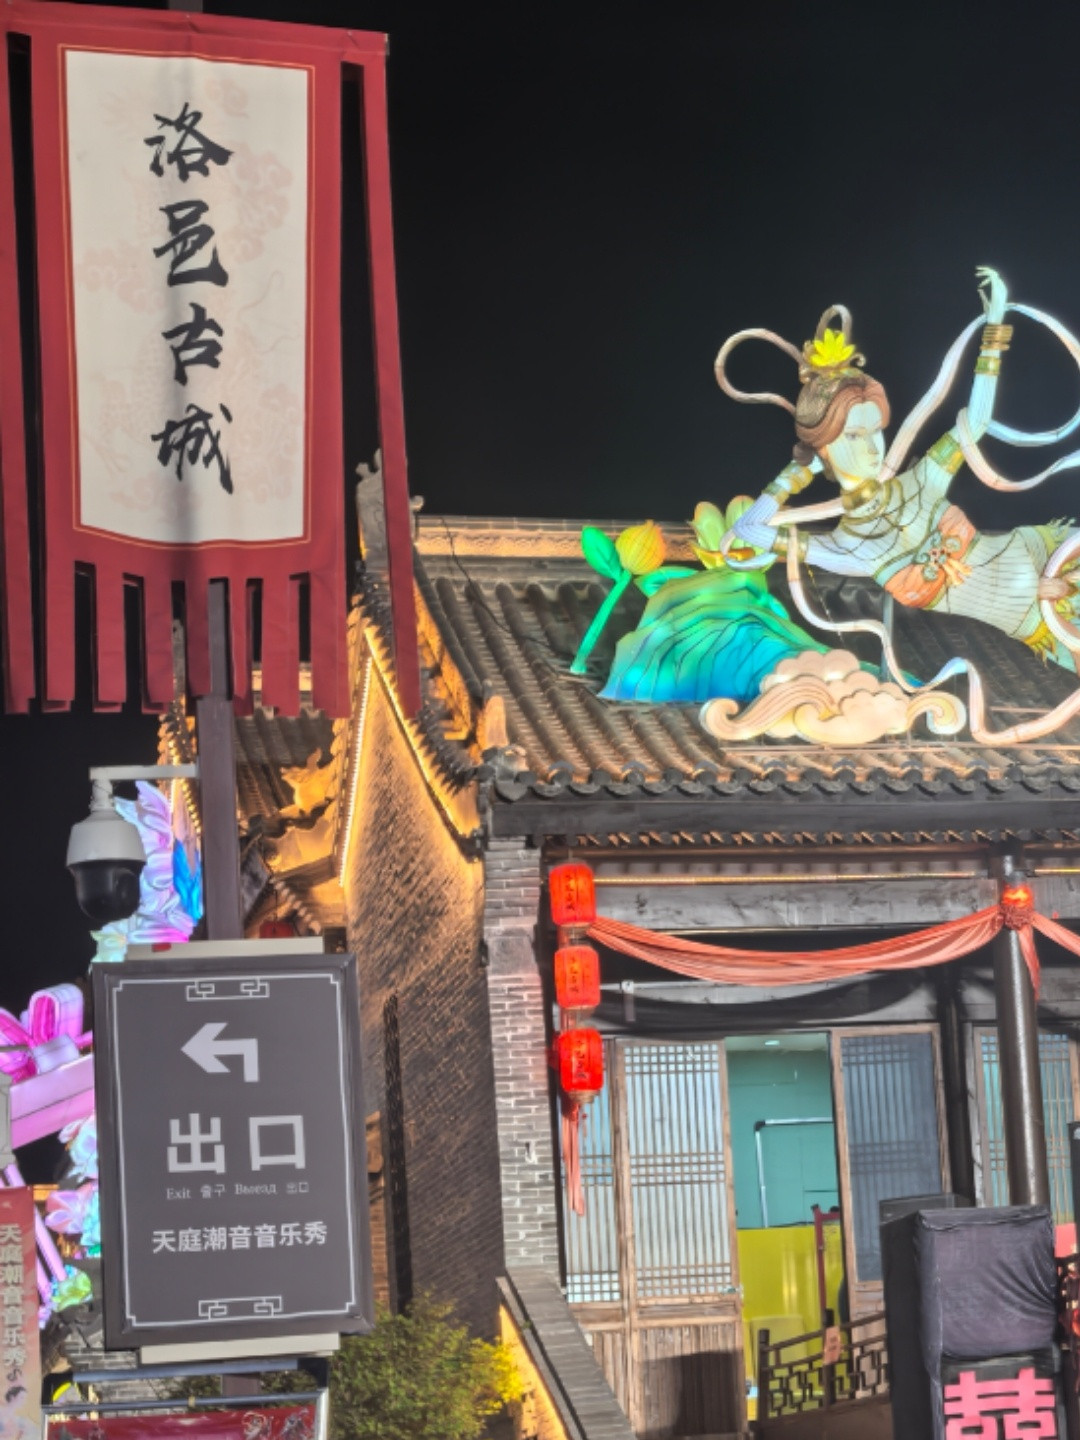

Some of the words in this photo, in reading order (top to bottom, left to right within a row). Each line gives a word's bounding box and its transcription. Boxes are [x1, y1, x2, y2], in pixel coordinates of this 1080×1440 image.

[144, 102, 234, 494] 洛邑古城
[167, 1113, 305, 1173] 出口
[166, 1187, 191, 1200] Exit
[152, 1221, 328, 1254] 天庭潮音音乐秀
